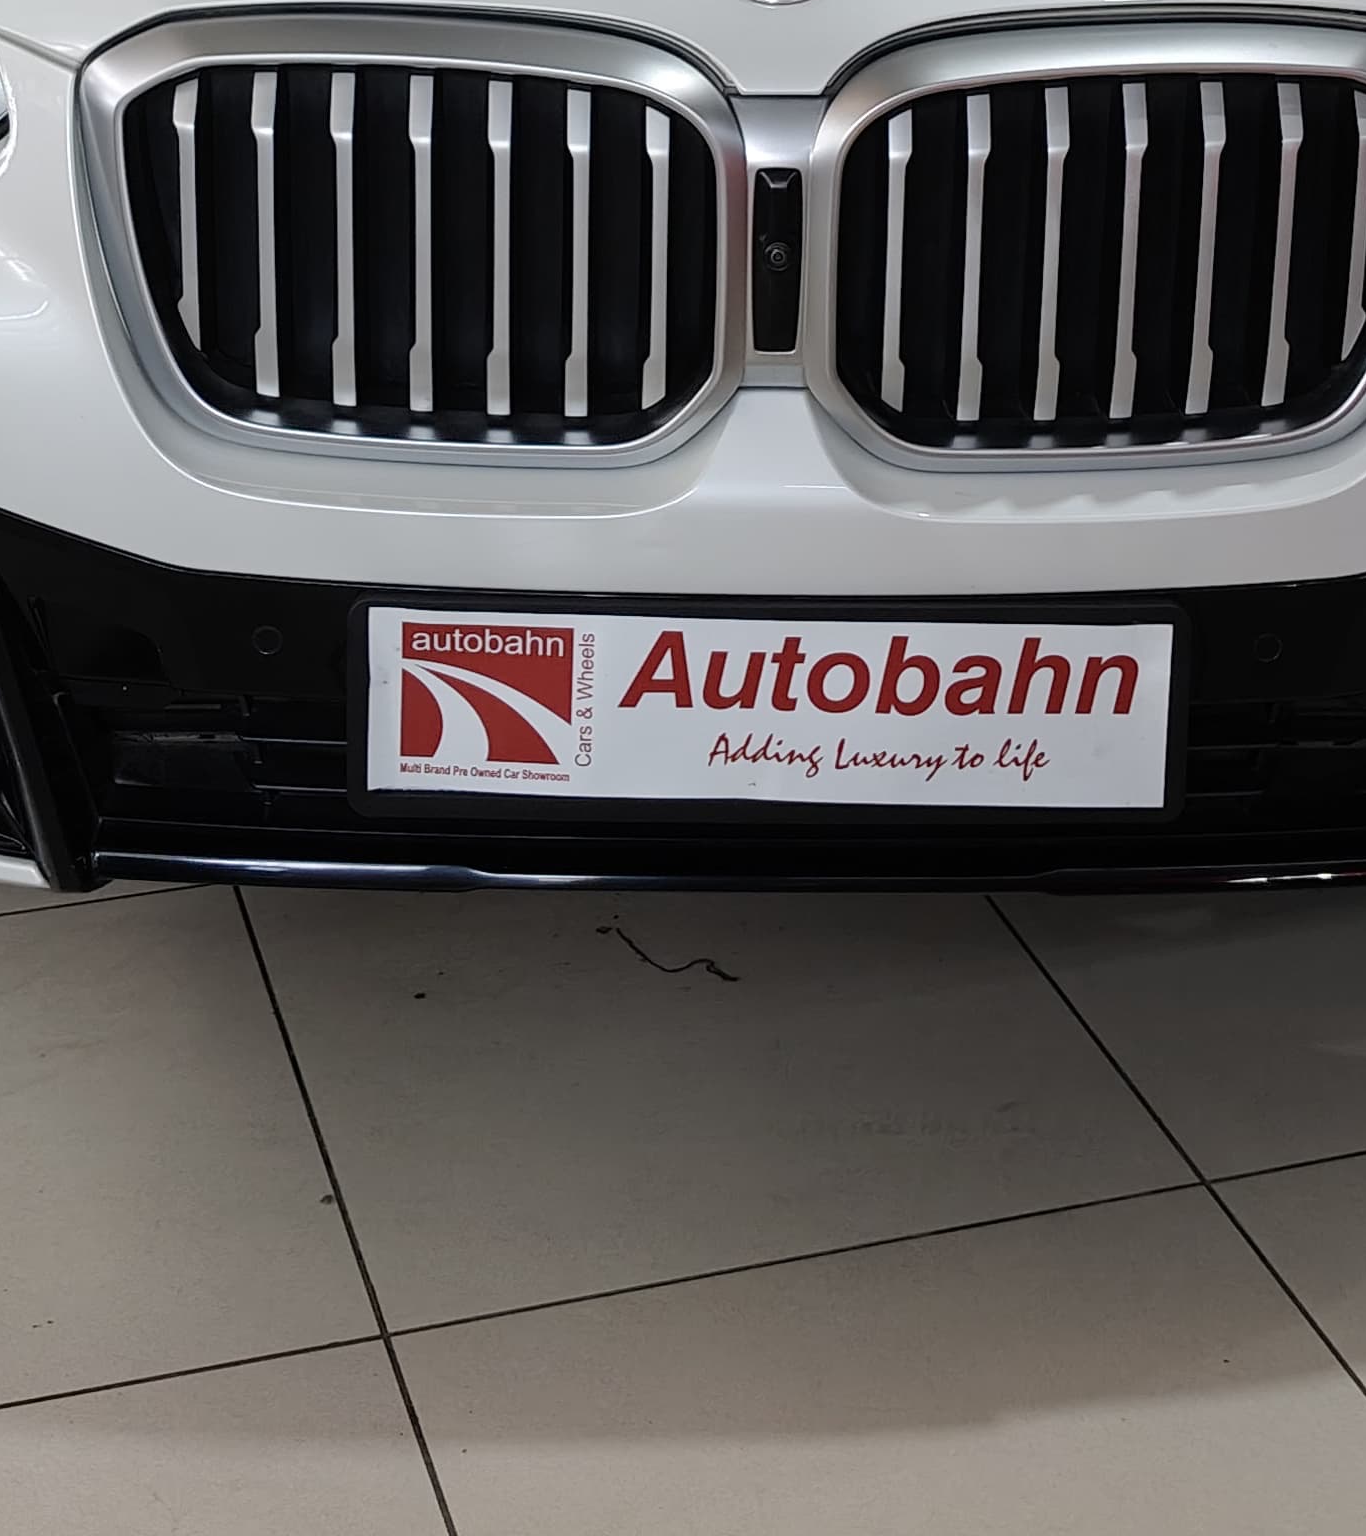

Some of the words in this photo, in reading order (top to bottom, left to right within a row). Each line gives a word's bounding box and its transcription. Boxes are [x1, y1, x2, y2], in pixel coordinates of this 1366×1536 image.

[411, 628, 565, 658] autobahn
[575, 632, 596, 701] Wheels
[618, 630, 1140, 717] Autobahn
[575, 706, 594, 720] &
[574, 724, 594, 768] Cars
[706, 731, 825, 779] Adding
[834, 737, 948, 782] Luxury
[952, 742, 984, 770] to
[993, 738, 1051, 782] life
[399, 762, 422, 774] Multi
[423, 765, 451, 776] Brand
[453, 767, 469, 778] Pre
[470, 766, 502, 779] Owned
[503, 768, 520, 780] Car
[522, 769, 571, 782] Showroom
